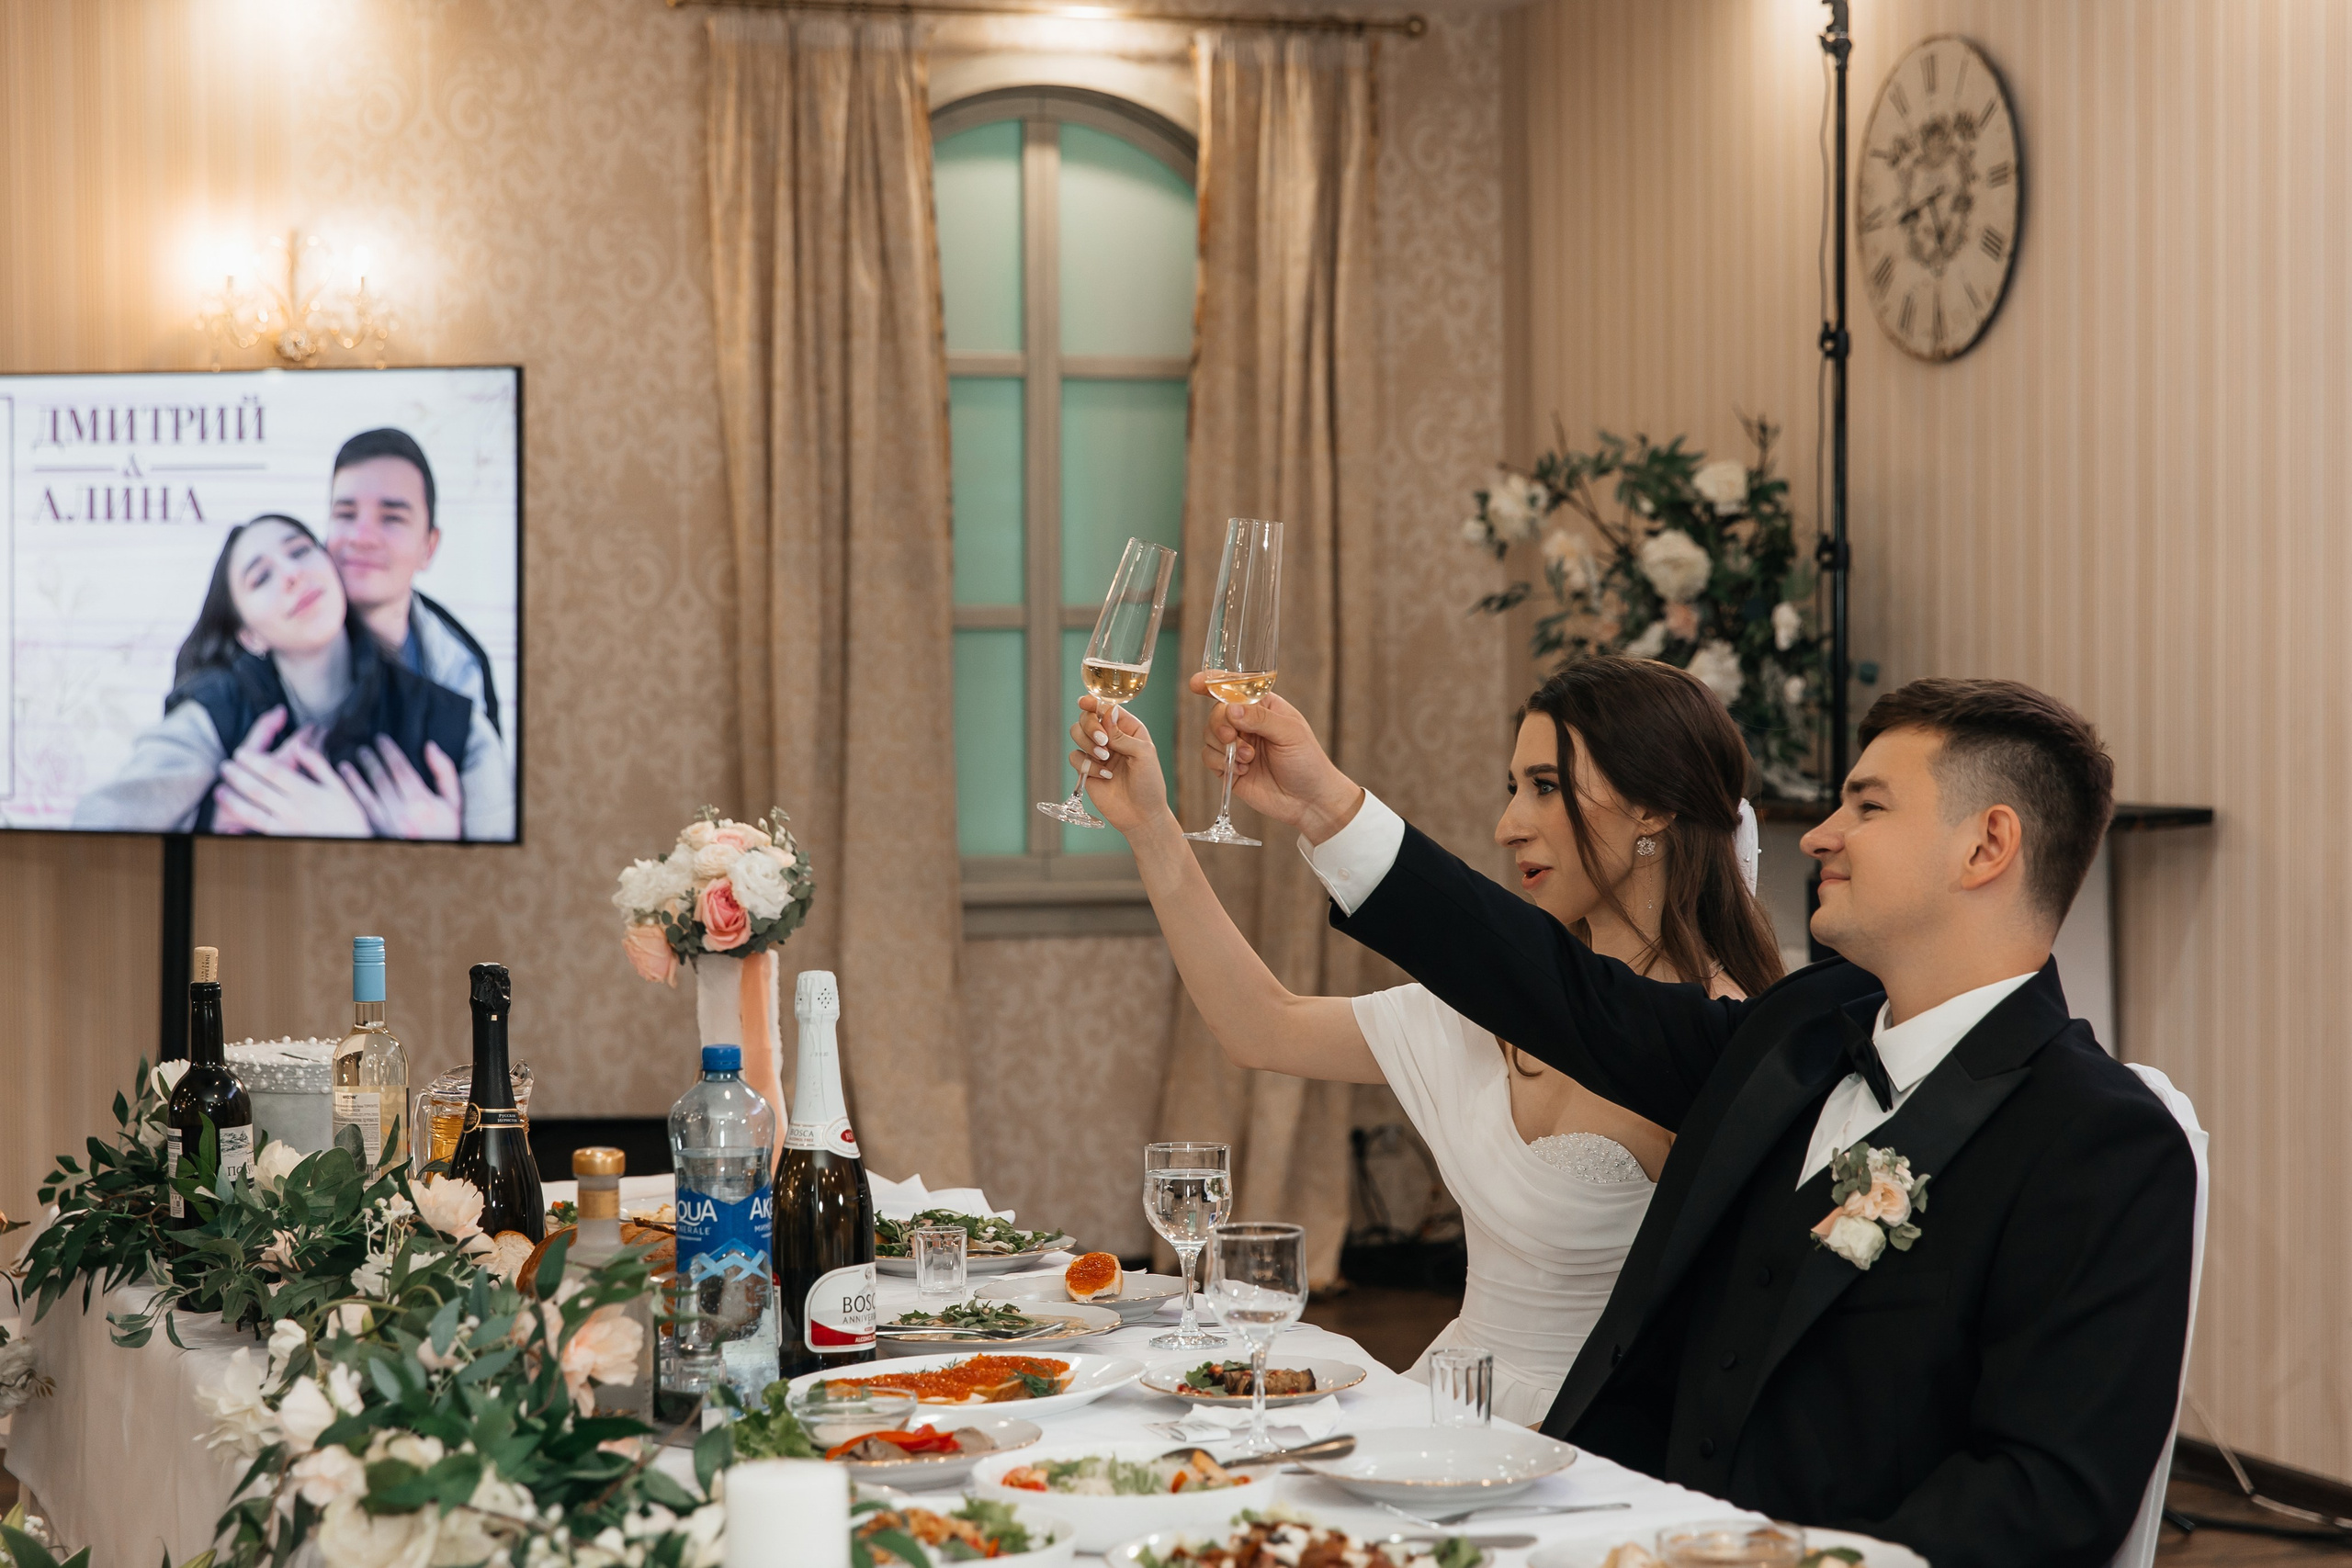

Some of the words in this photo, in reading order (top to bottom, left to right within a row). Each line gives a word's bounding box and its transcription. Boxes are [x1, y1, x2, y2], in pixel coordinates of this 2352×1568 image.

[31, 393, 267, 451] ДМИТРИЙ
[122, 453, 143, 478] &
[34, 484, 205, 524] АЛИНА
[789, 1128, 814, 1138] BOSCA
[677, 1224, 711, 1236] NERALE
